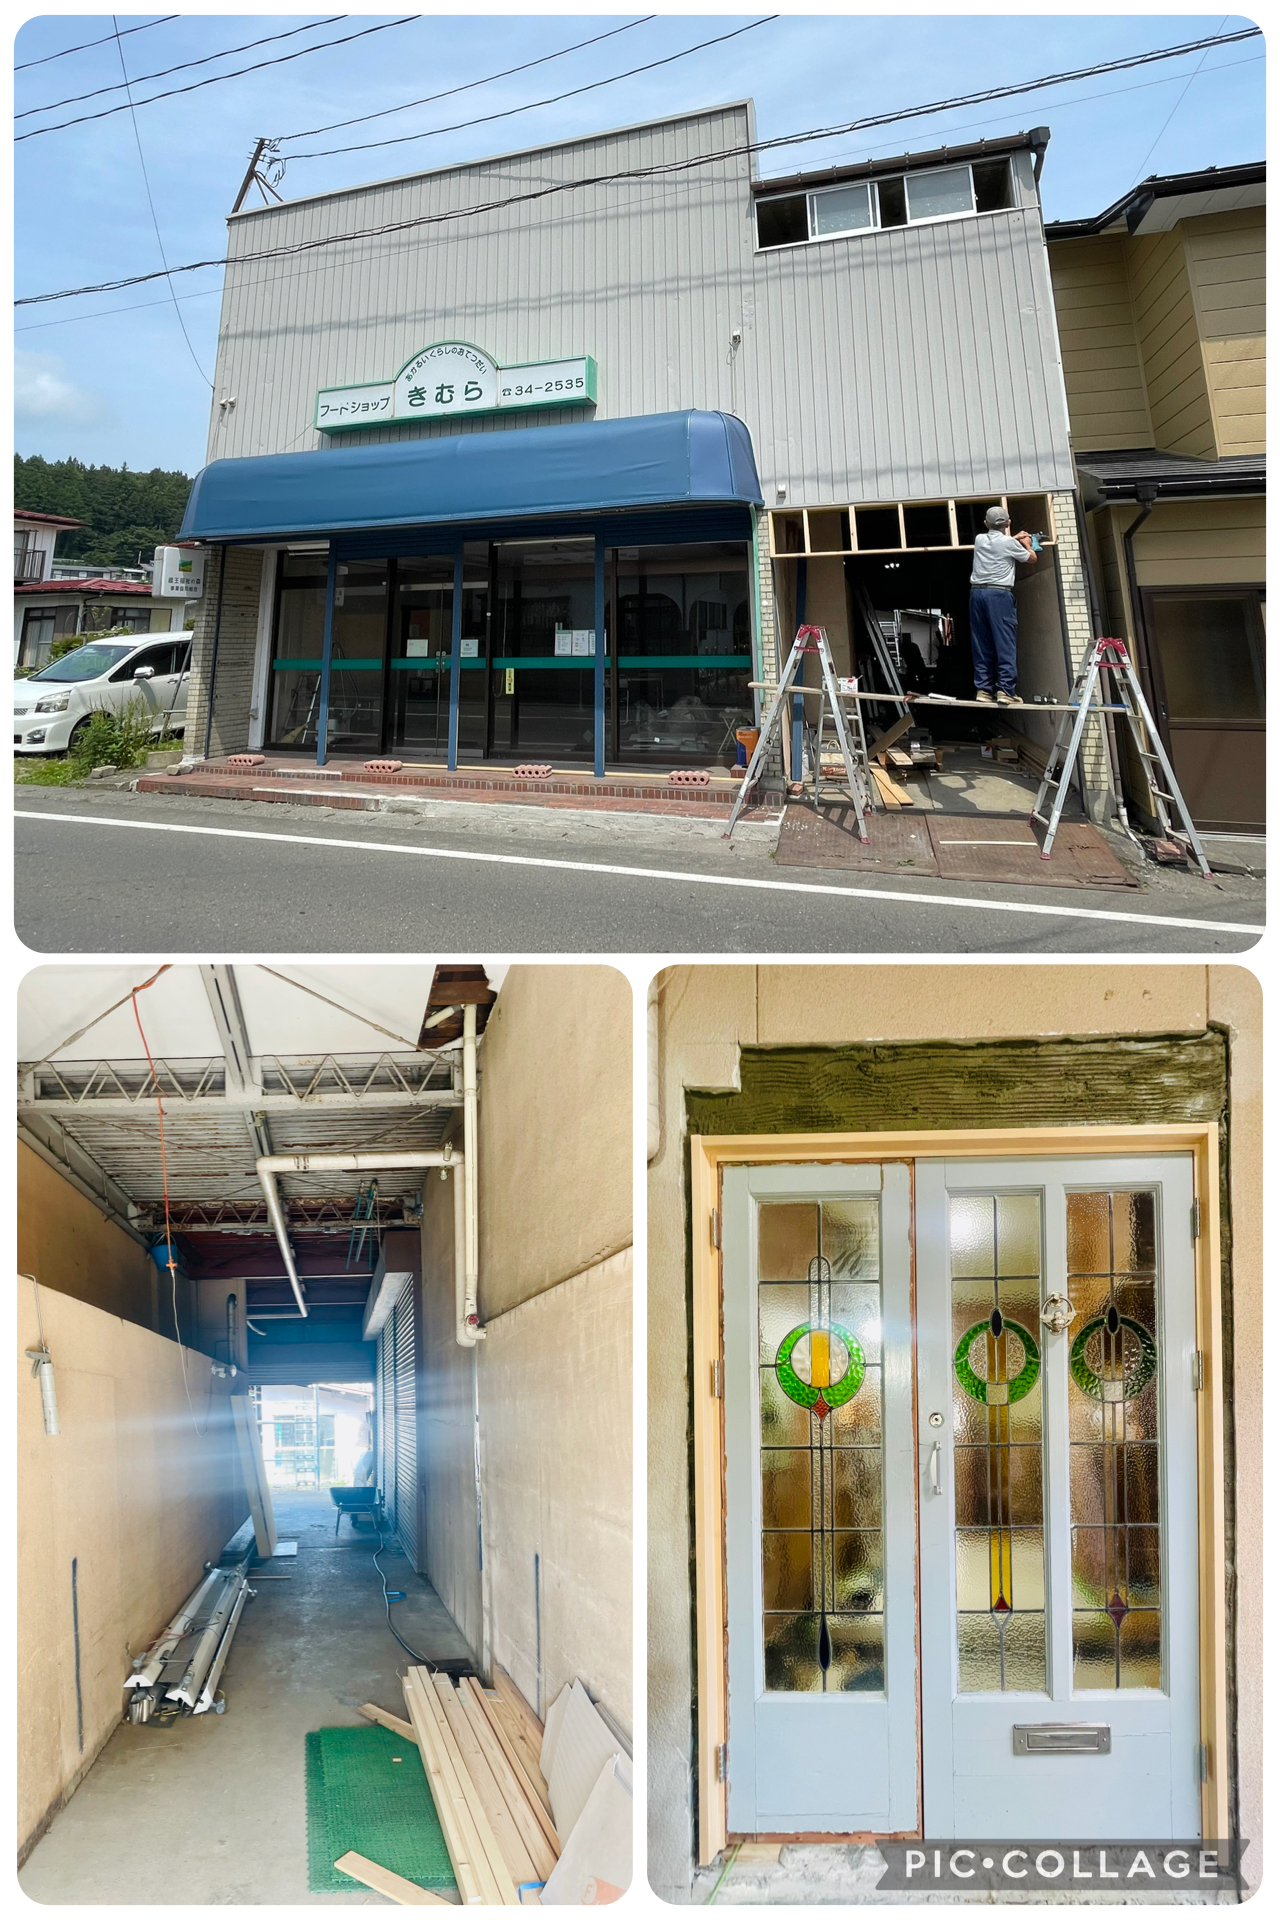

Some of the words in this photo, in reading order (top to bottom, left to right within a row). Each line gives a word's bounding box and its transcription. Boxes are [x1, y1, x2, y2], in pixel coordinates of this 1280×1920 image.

[405, 347, 487, 382] あかるいくらしのおてつだい
[407, 381, 483, 407] きむら
[319, 397, 391, 418] フードショップ
